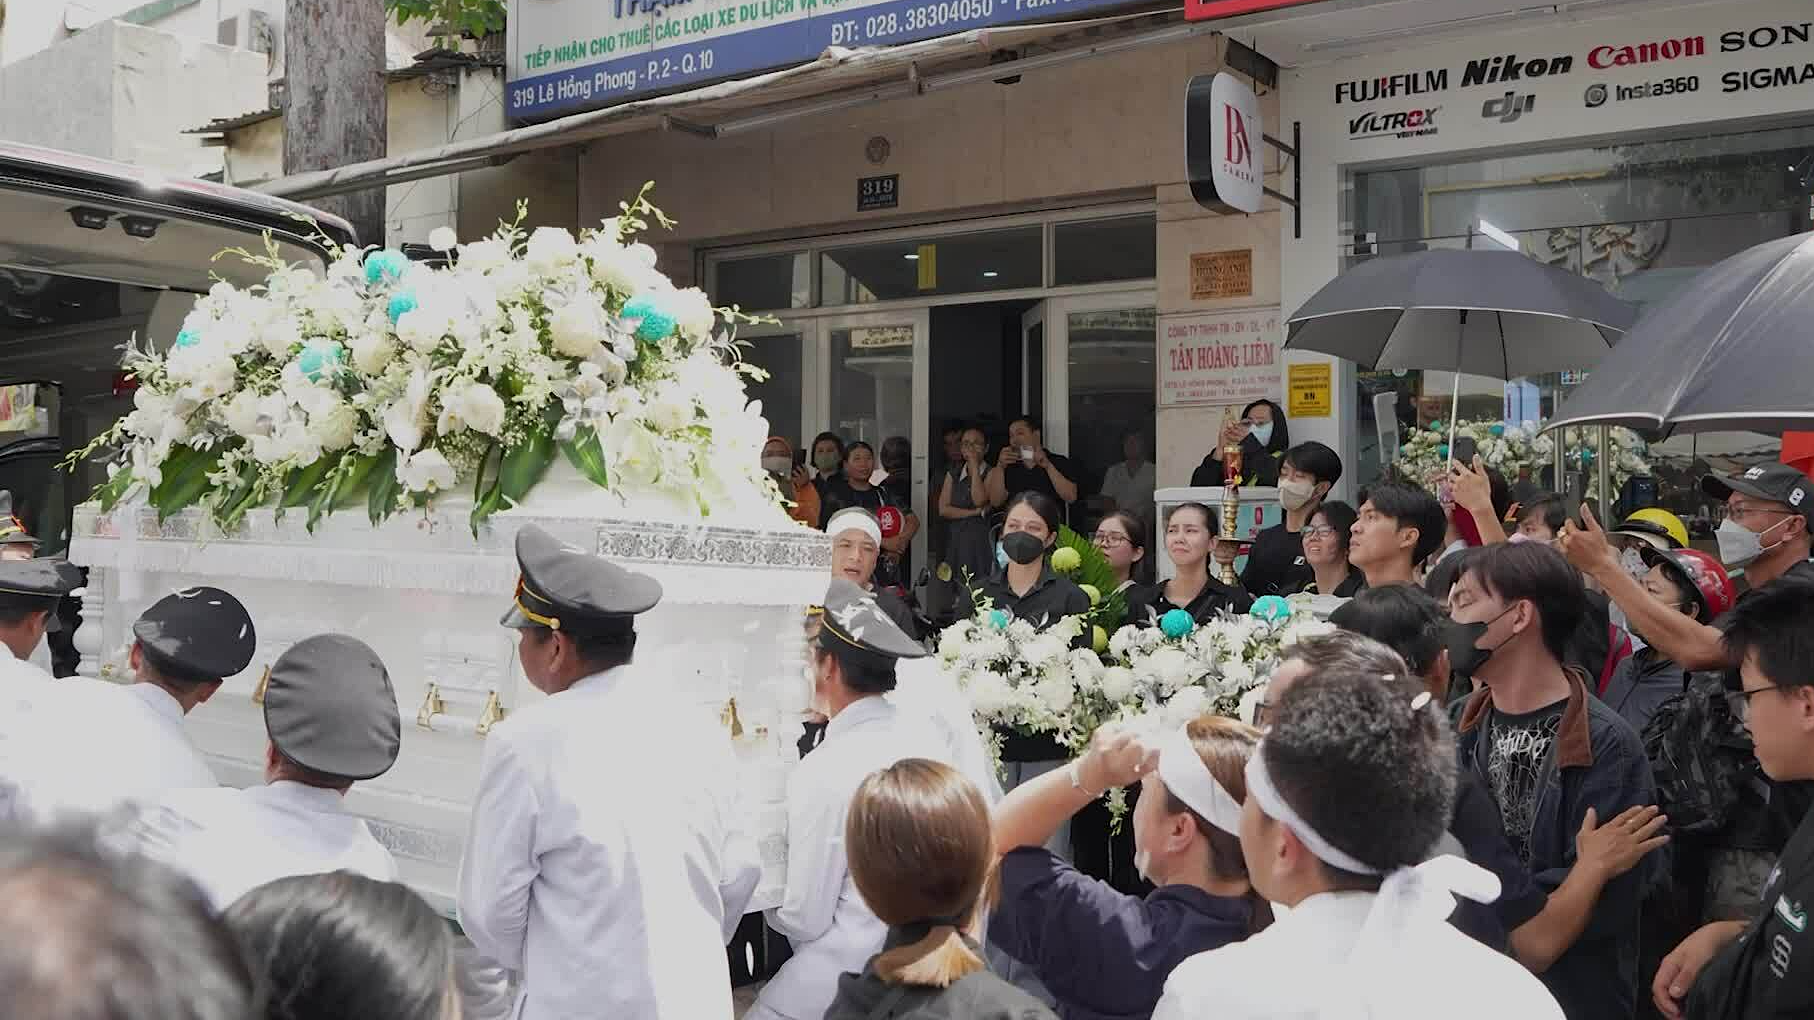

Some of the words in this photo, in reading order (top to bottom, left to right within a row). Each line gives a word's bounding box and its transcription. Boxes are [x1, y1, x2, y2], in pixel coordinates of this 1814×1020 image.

[525, 43, 551, 69] TIẾP
[554, 40, 586, 63] NHẬN
[591, 35, 616, 56] CHO
[618, 24, 650, 50] THUÊ
[655, 18, 680, 40] CÁC
[684, 12, 713, 34] LOẠI
[718, 7, 736, 28] XE
[740, 4, 758, 22] DU
[762, 0, 793, 19] LỊCH
[831, 20, 859, 44] ĐT:
[866, 0, 992, 38] 028.38304050
[1587, 36, 1705, 69] Canon
[1335, 69, 1448, 104] FUJIFILM
[1460, 55, 1573, 88] Nikon
[513, 88, 534, 108] 319
[539, 83, 554, 103] Lê
[558, 75, 591, 99] Hồng
[595, 70, 636, 92] Phong
[1615, 75, 1700, 102] Insta360
[1349, 108, 1438, 134] VILTROX
[863, 179, 893, 196] 319
[1198, 340, 1239, 369] HOÀNG
